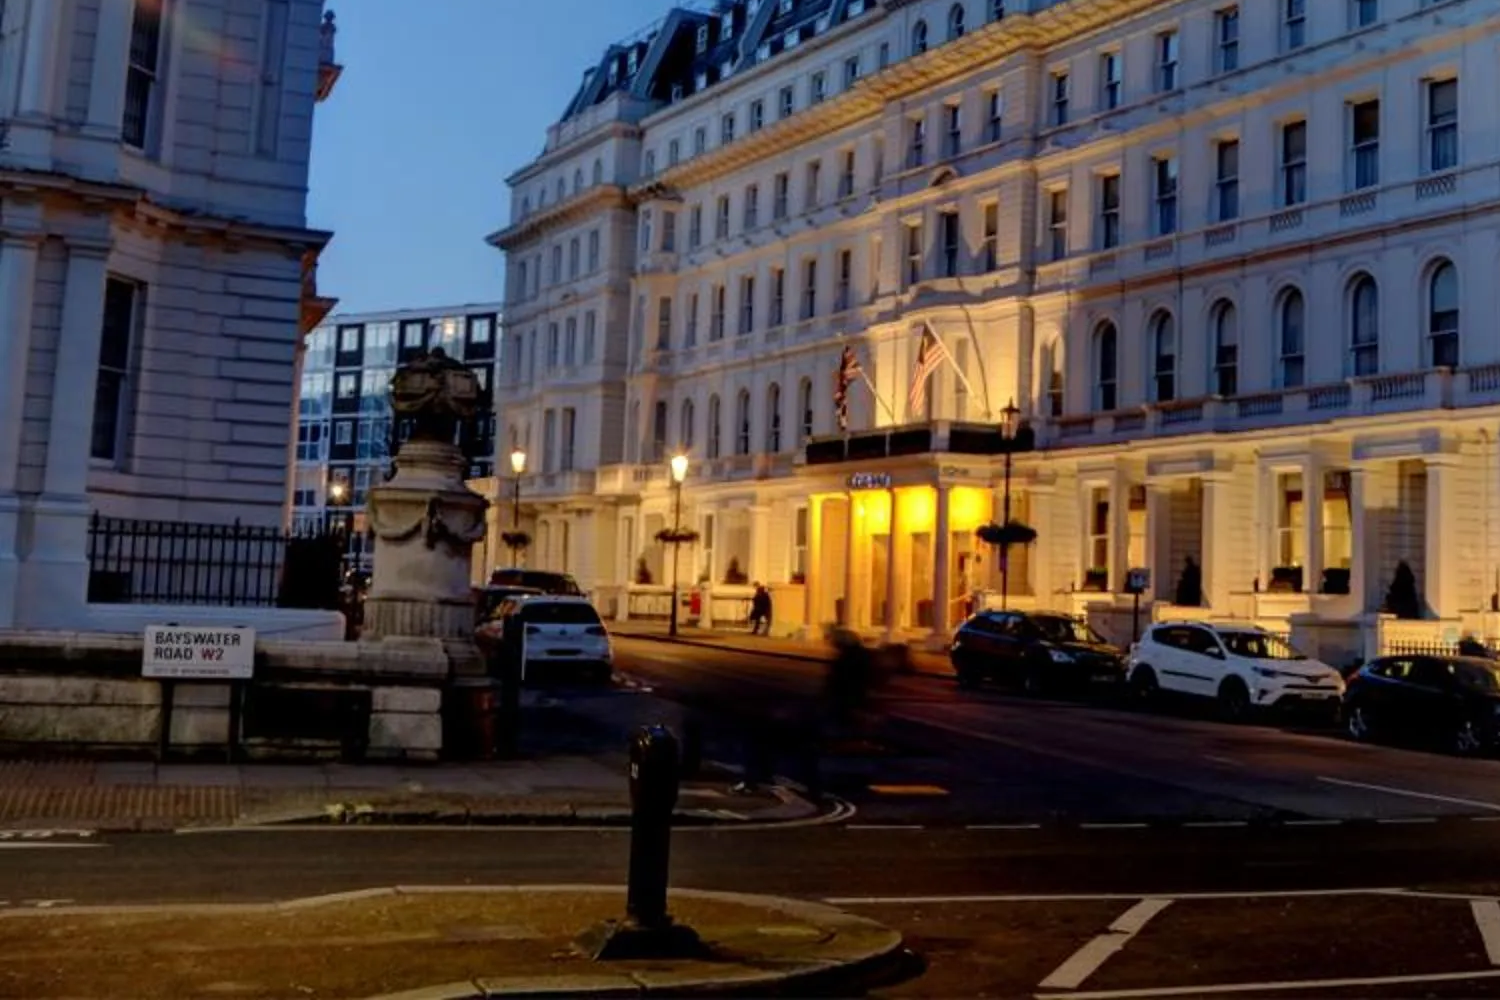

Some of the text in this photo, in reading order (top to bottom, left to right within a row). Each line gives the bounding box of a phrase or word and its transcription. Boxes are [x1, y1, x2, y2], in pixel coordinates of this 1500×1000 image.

[155, 631, 241, 646] BAYSWATER
[154, 646, 225, 661] ROAD W2
